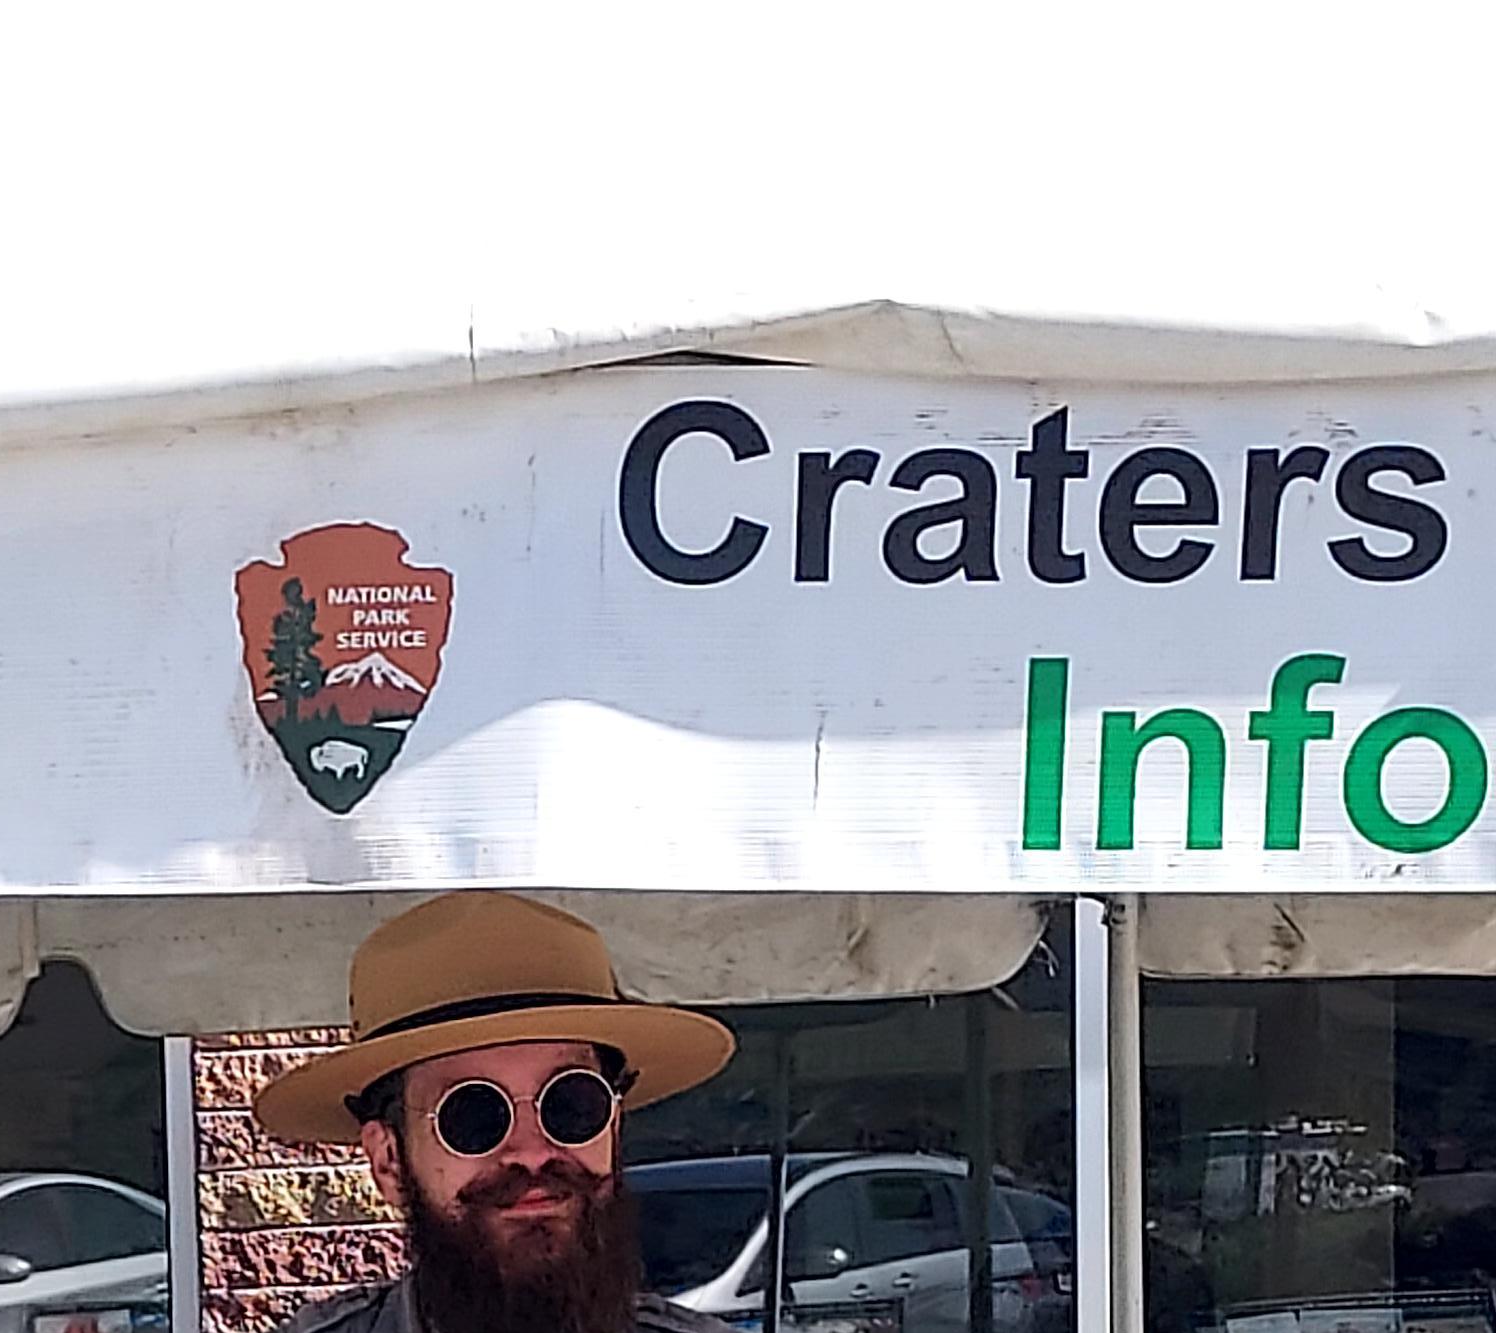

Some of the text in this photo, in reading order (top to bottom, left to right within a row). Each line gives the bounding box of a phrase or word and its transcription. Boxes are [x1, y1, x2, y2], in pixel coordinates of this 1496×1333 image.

[618, 400, 1448, 586] Craters
[327, 585, 437, 605] NATIONAL
[353, 608, 410, 625] PARK
[336, 630, 427, 649] SERVICE
[1022, 652, 1489, 854] Info
